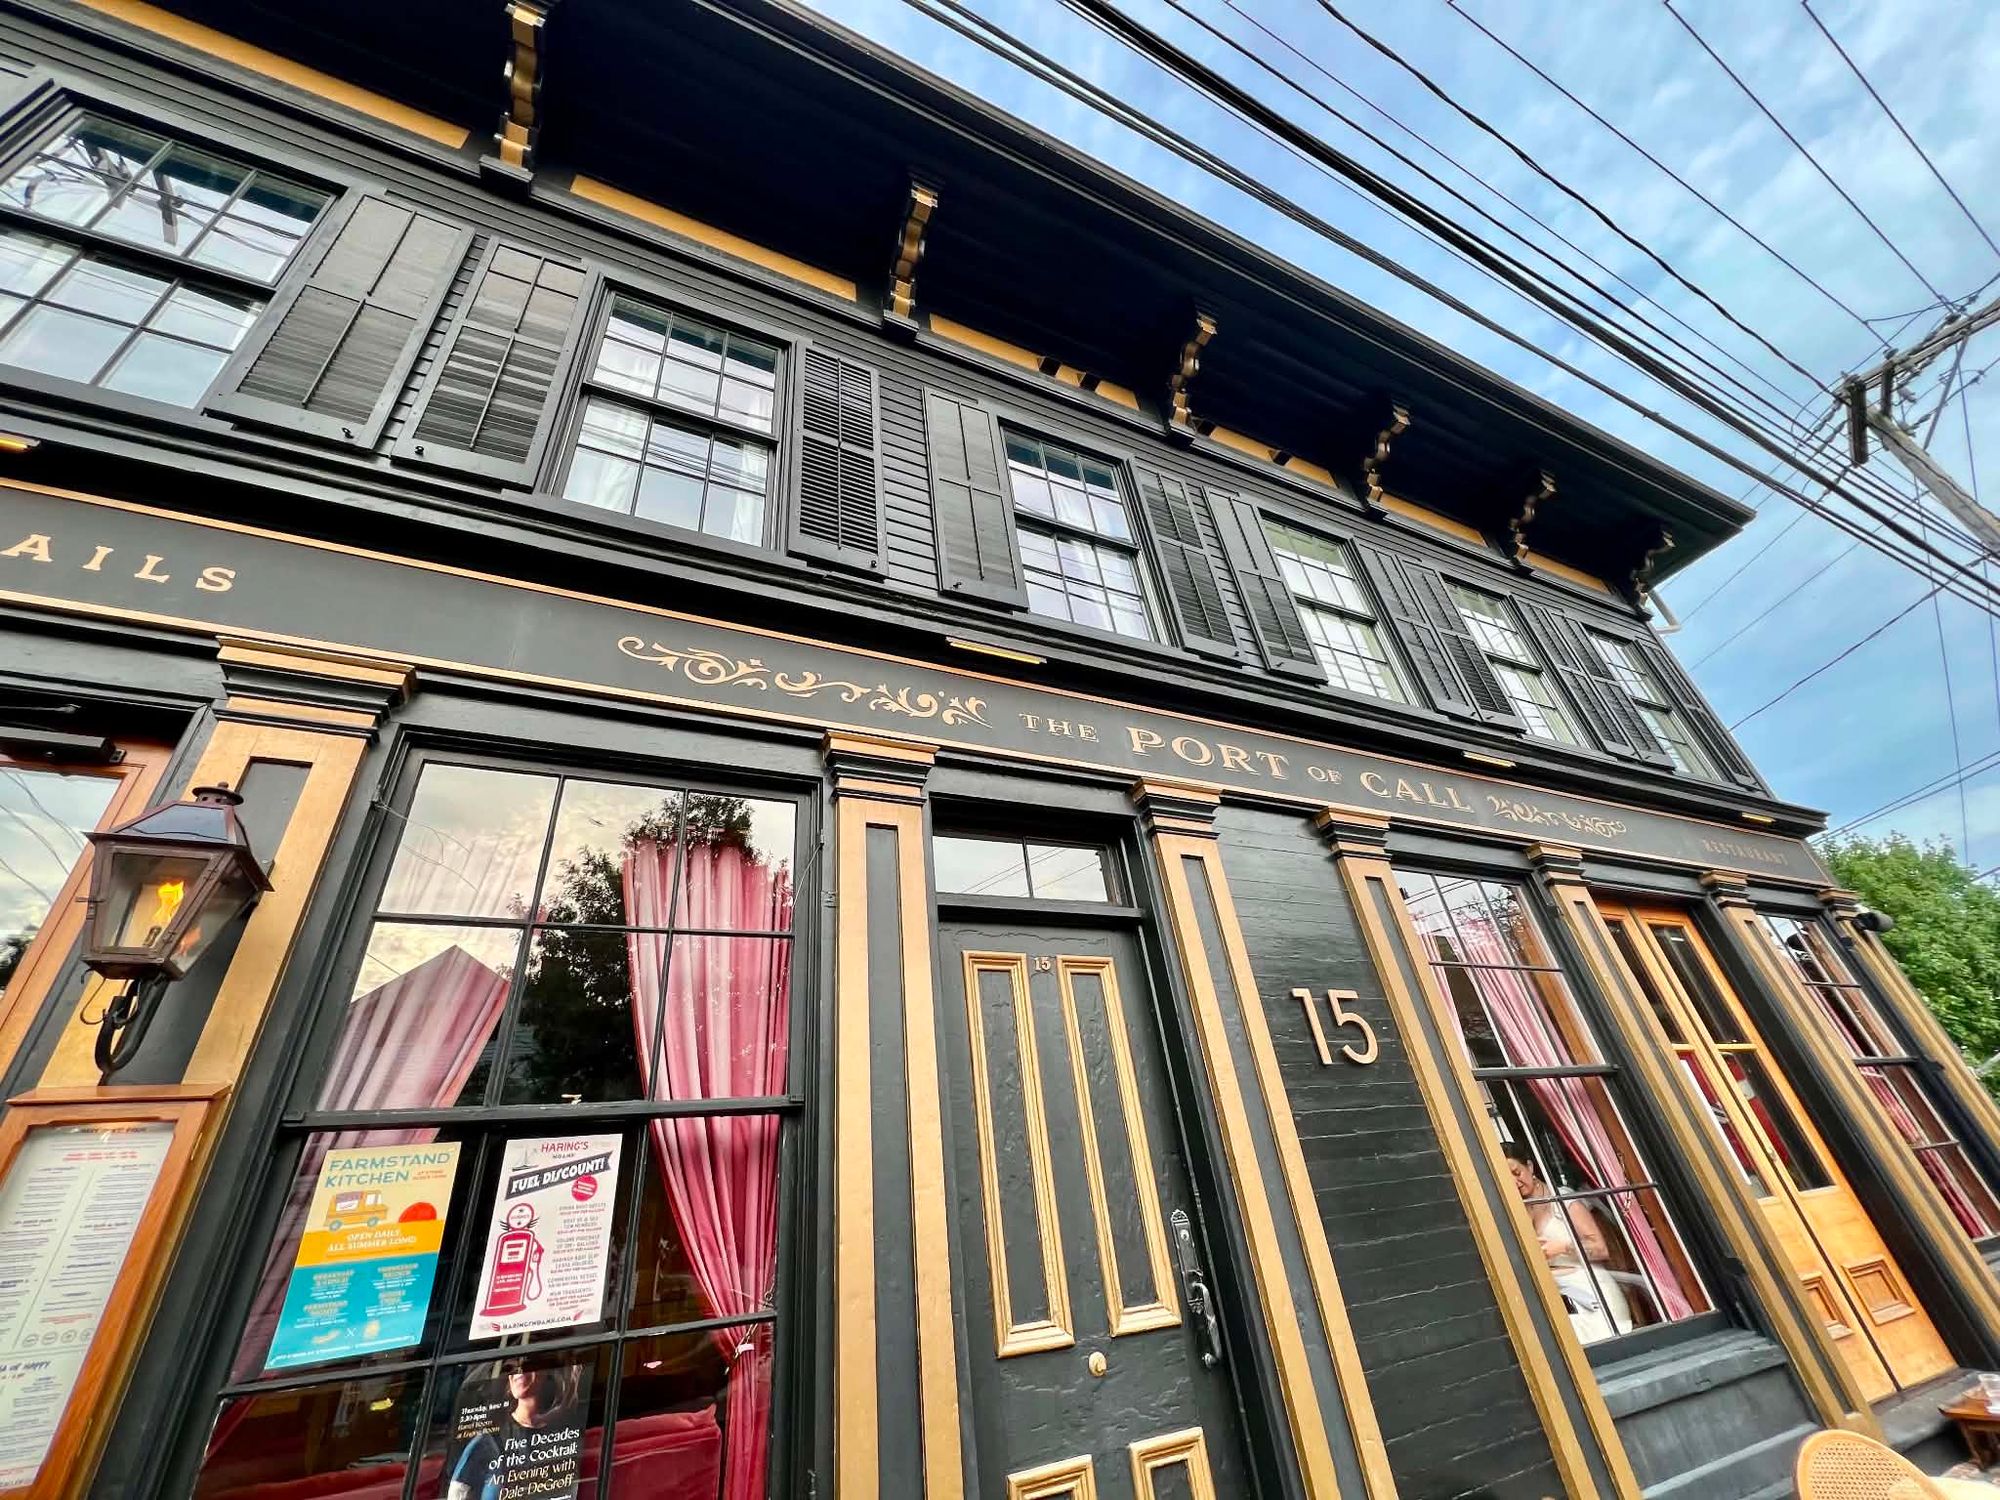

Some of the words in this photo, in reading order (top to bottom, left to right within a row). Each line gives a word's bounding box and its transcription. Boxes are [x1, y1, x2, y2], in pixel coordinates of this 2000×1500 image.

[0, 534, 237, 592] AILS
[1019, 713, 1100, 743] THE
[1126, 726, 1290, 779] PORT
[1307, 765, 1343, 784] OF
[1360, 771, 1474, 813] CALL
[1034, 956, 1051, 971] 15
[1292, 988, 1378, 1064] 15
[541, 1141, 589, 1153] HARING'S
[329, 1152, 451, 1172] FARMSTAND
[511, 1174, 540, 1194] FUEL
[542, 1157, 606, 1185] DISCOUNT!
[325, 1170, 410, 1188] KITCHEN
[505, 1438, 527, 1451] Five
[531, 1427, 580, 1446] Decades
[489, 1455, 504, 1470] of
[506, 1453, 526, 1467] the
[529, 1442, 578, 1461] Cocktail:
[488, 1473, 505, 1487] An
[507, 1465, 550, 1483] Evening
[552, 1458, 576, 1473] with
[499, 1485, 524, 1500] Dale
[528, 1473, 574, 1495] DeGroff
